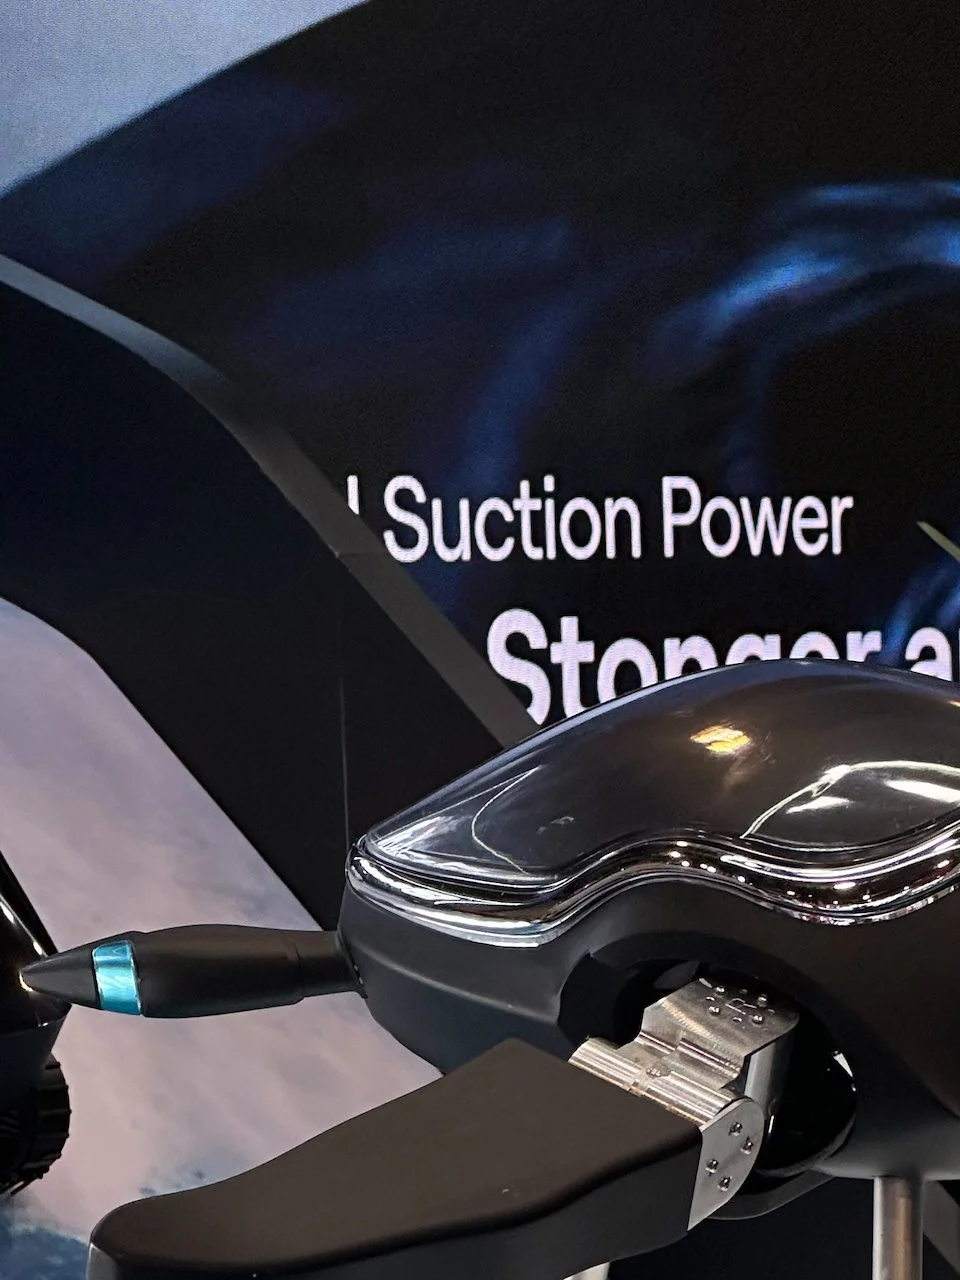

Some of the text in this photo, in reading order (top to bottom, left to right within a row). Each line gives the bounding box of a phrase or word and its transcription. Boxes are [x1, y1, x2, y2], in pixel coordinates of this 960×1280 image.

[383, 474, 642, 563] Suction
[661, 475, 854, 559] Power
[486, 608, 882, 725] Stonr
